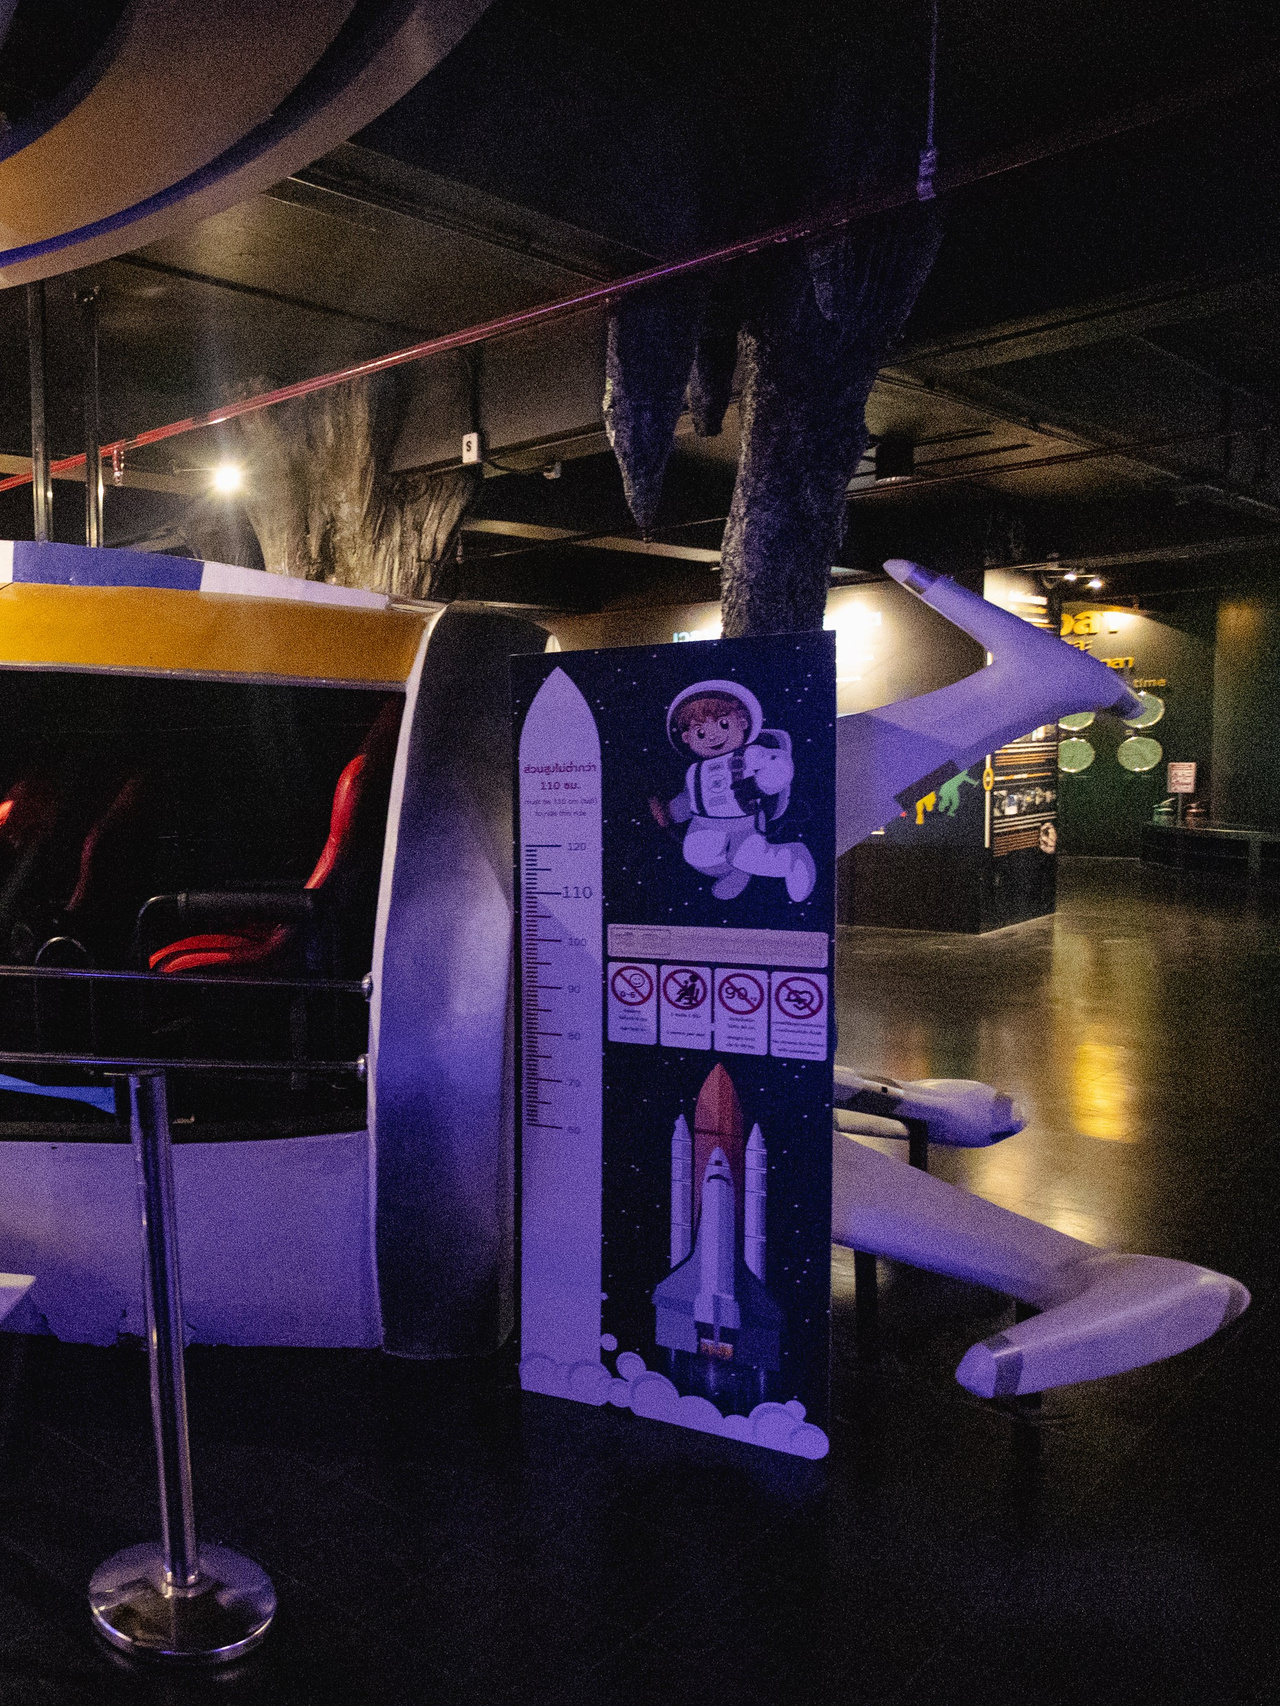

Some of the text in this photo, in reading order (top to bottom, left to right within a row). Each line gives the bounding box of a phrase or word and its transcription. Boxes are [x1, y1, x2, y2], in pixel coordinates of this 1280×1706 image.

[1133, 678, 1167, 688] time
[540, 782, 561, 790] 110
[567, 842, 587, 851] 120
[562, 886, 593, 899] 110
[568, 938, 587, 946] 100
